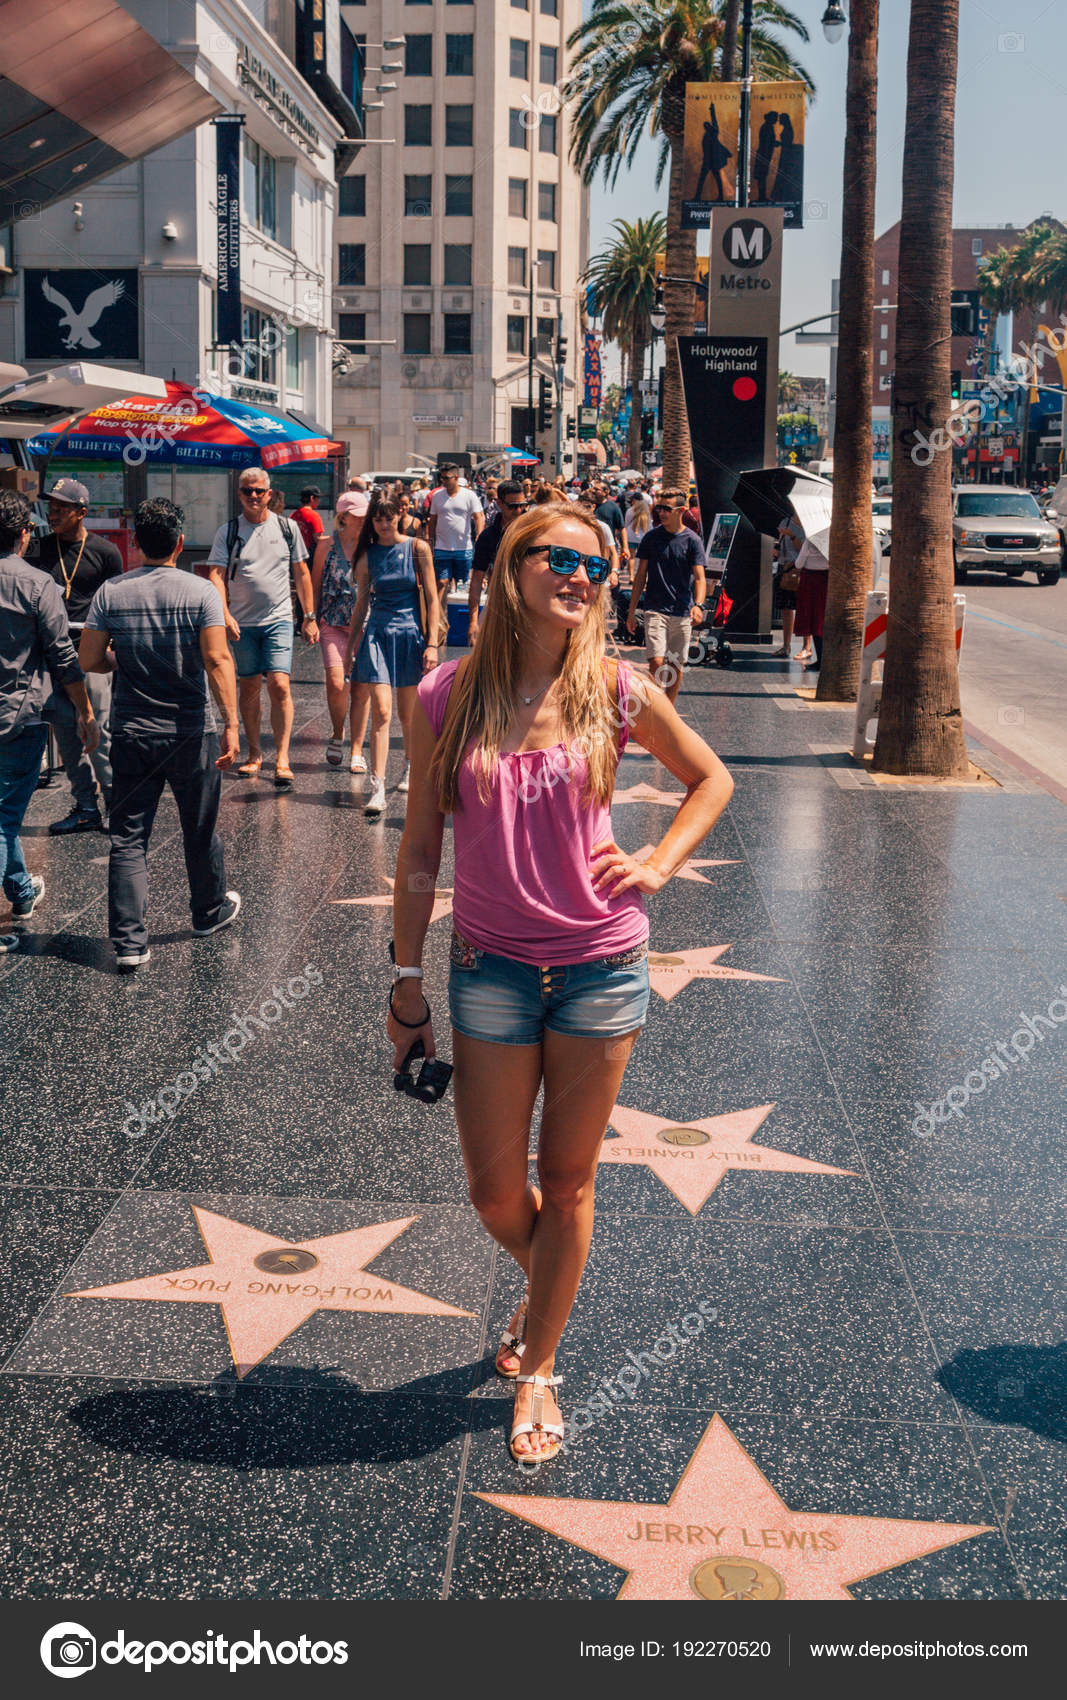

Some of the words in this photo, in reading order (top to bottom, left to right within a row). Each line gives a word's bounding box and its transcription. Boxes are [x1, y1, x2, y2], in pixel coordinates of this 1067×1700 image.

[218, 174, 228, 216] EAGLE
[229, 199, 239, 267] OUTFITTERS
[731, 227, 763, 260] M
[218, 223, 229, 292] AMERICAN
[720, 274, 771, 291] Metro
[588, 340, 602, 371] WAX
[690, 345, 759, 359] Hollywood/
[705, 359, 757, 374] Highland
[68, 440, 121, 451] BILHETES
[176, 447, 222, 460] BILLETS
[610, 1146, 694, 1159] DANIELS
[707, 1152, 761, 1163] BILLY
[162, 1277, 230, 1292] PUCK
[247, 1281, 394, 1301] WOLFGANG
[627, 1522, 725, 1545] JERRY
[742, 1528, 838, 1551] LEWIS
